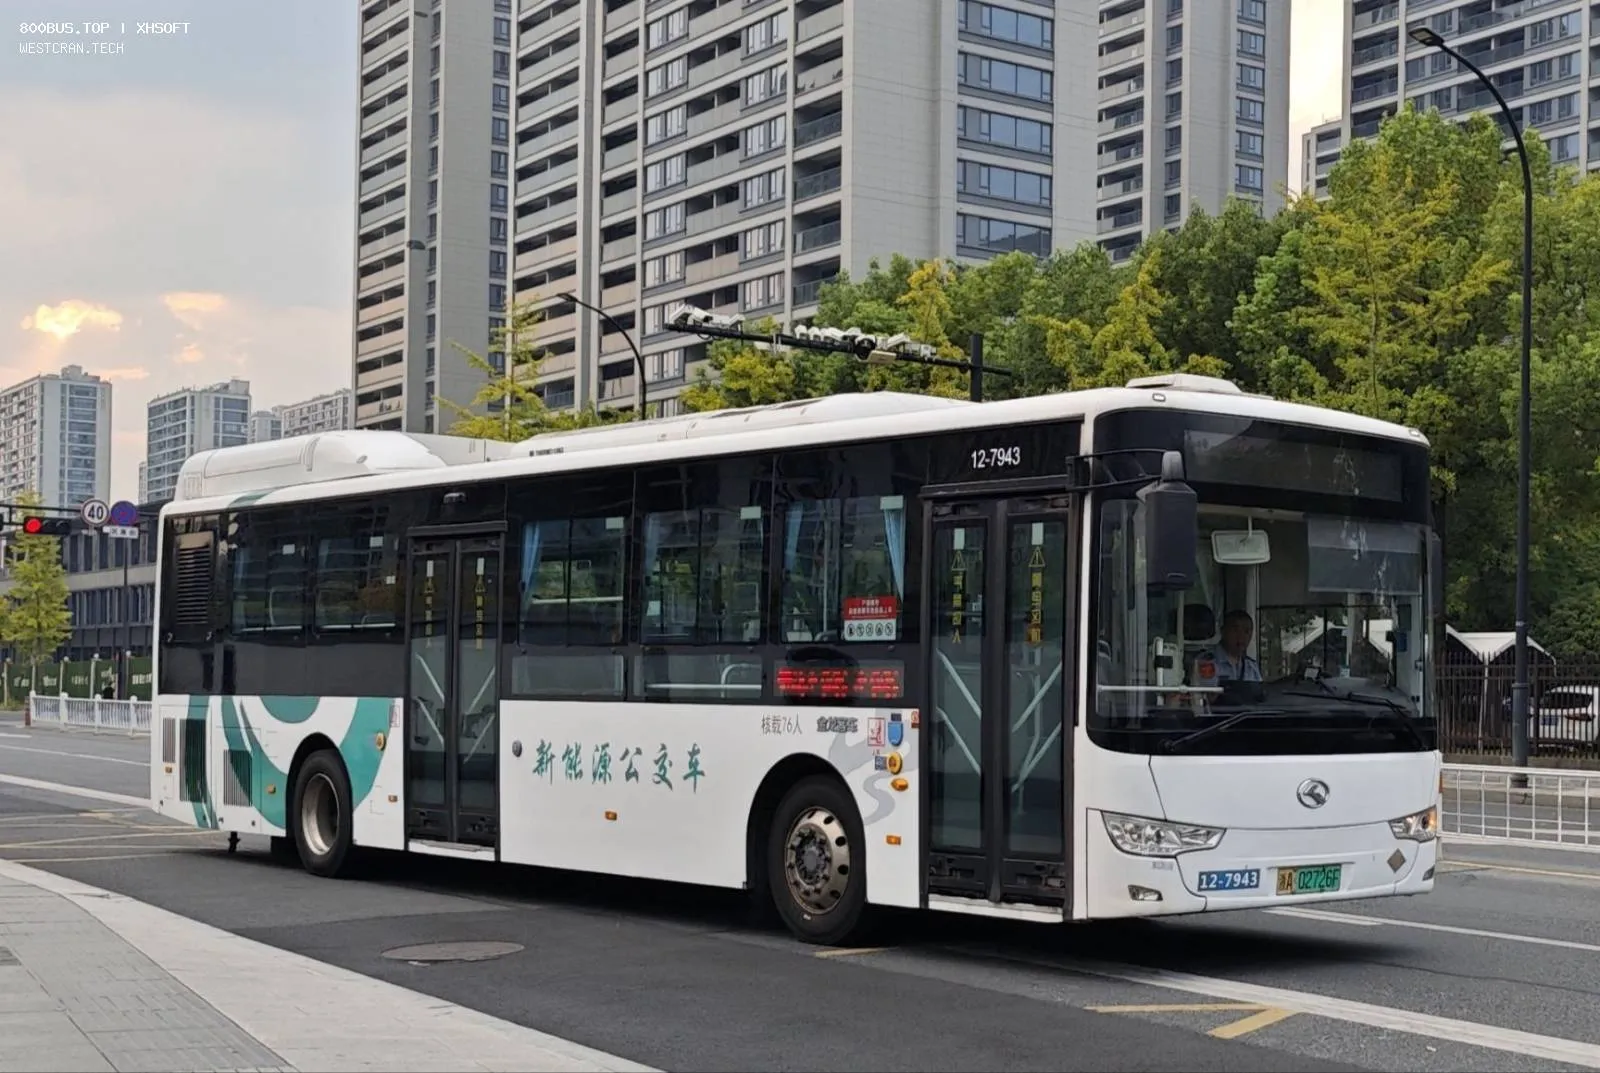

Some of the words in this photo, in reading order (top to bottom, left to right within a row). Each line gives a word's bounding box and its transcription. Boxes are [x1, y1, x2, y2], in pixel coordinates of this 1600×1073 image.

[971, 446, 1021, 468] 12-7943
[87, 505, 104, 520] 40
[532, 737, 706, 794] 新能源公交车
[1200, 871, 1258, 889] 12-7943
